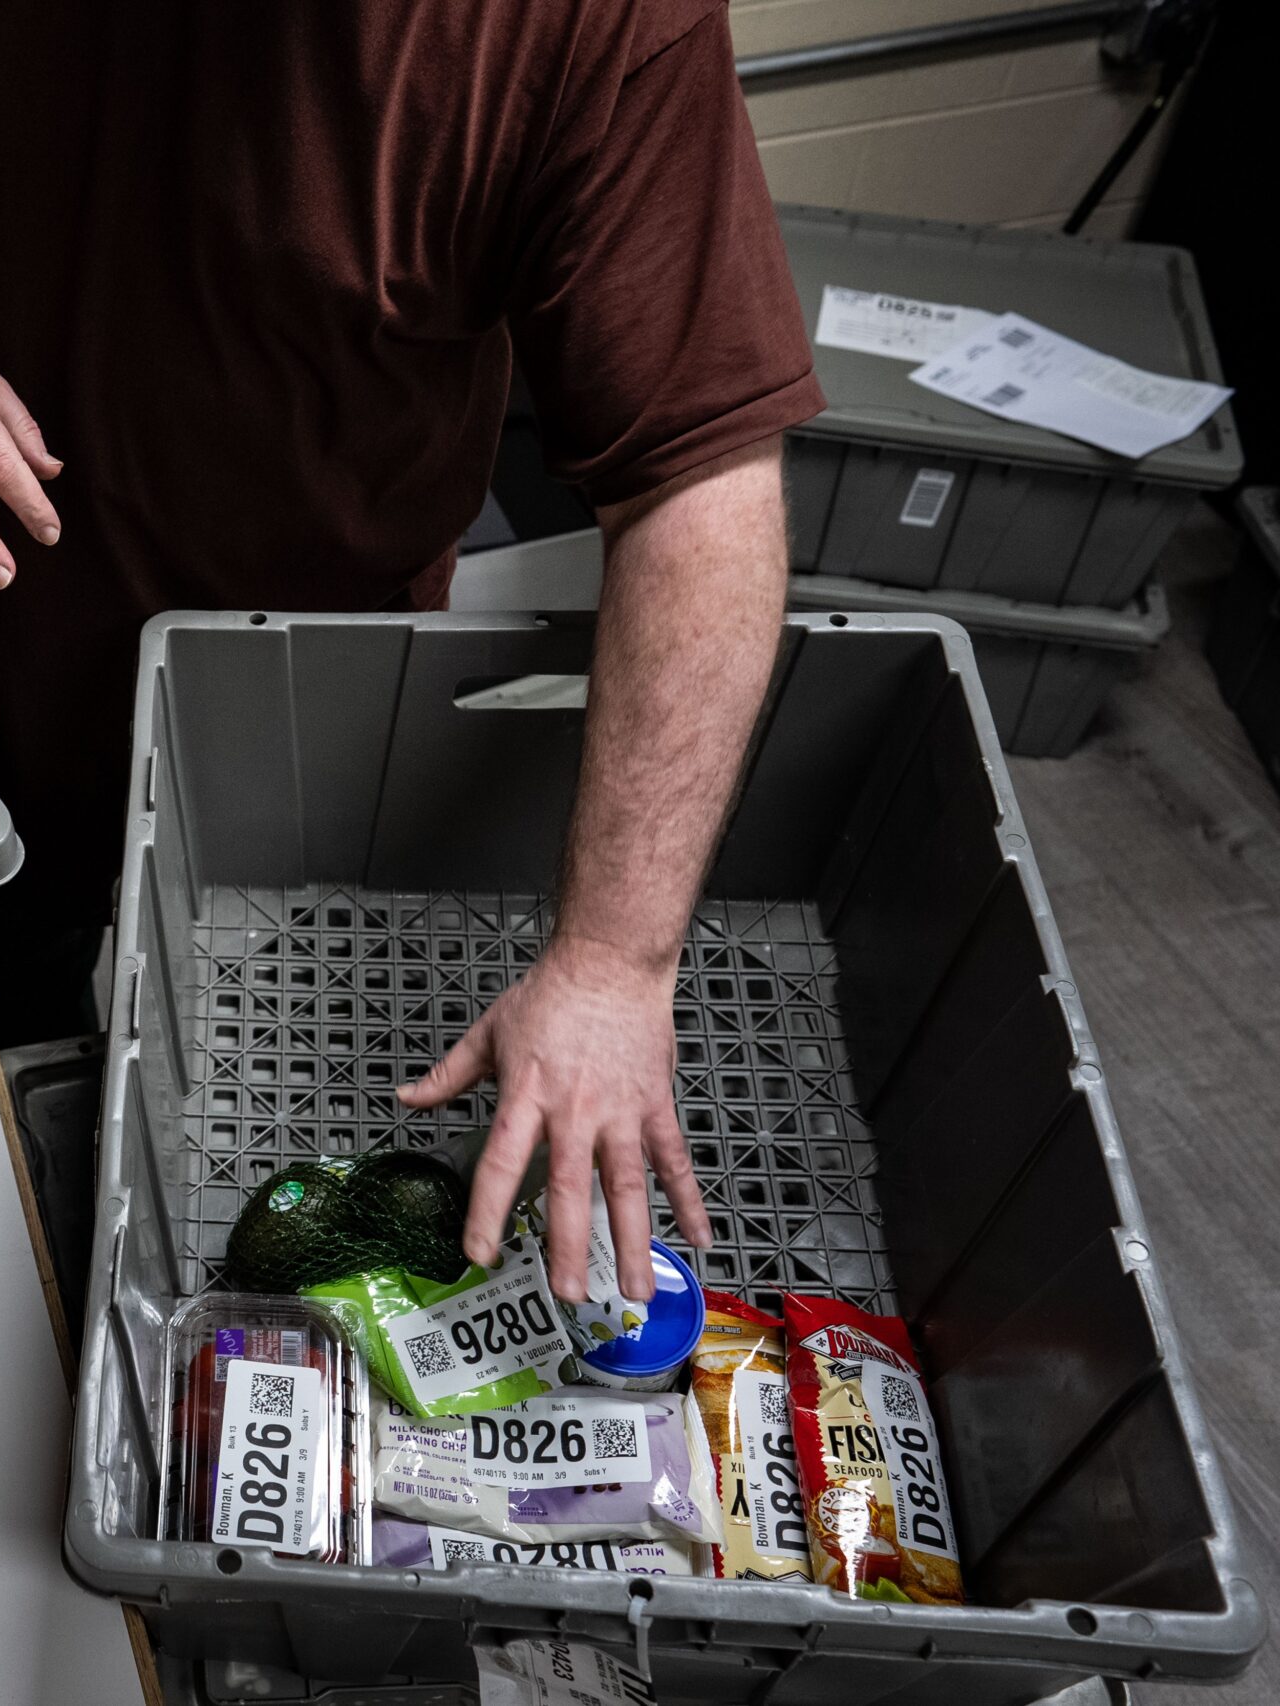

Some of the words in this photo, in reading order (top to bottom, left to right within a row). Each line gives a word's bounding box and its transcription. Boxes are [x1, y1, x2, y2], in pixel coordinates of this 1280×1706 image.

[597, 1241, 616, 1268] MEXICO
[503, 1274, 533, 1291] 49740176
[475, 1293, 488, 1303] AM
[487, 1286, 501, 1298] 9:00
[457, 1300, 470, 1311] 3/9
[431, 1310, 447, 1321] Subs
[450, 1289, 557, 1365] D826
[523, 1338, 566, 1361] Bowman,
[825, 1329, 907, 1373] LOUISIANA
[514, 1355, 525, 1368] K
[475, 1371, 485, 1381] 23
[483, 1364, 500, 1377] Bulk
[520, 1400, 529, 1413] K
[551, 1404, 567, 1412] Bulk
[568, 1404, 576, 1412] 15
[229, 1424, 237, 1433] 13
[300, 1416, 310, 1432] Subs
[388, 1425, 417, 1433] MILK
[420, 1426, 467, 1440] CHOCOLA
[471, 1415, 587, 1464] D826
[227, 1434, 237, 1450] Bulk
[397, 1434, 438, 1448] BAKING
[441, 1441, 467, 1452] CHIP
[298, 1448, 309, 1462] 3/9
[748, 1446, 757, 1460] Bulk
[221, 1471, 234, 1482] K
[296, 1471, 307, 1485] AM
[473, 1468, 507, 1480] 49740176
[513, 1470, 530, 1481] 9:00
[531, 1472, 544, 1481] AM
[554, 1470, 567, 1480] 3/9
[583, 1468, 601, 1477] Subs
[834, 1464, 883, 1480] SEAFOOD
[891, 1472, 901, 1481] K
[236, 1421, 292, 1544] D826
[393, 1481, 406, 1493] NET
[405, 1483, 416, 1495] WT
[417, 1485, 429, 1498] 11.5
[429, 1488, 438, 1499] OZ
[750, 1482, 763, 1491] K
[891, 1425, 948, 1551] D826
[295, 1486, 306, 1504] 9:00
[762, 1432, 808, 1550] D826
[216, 1484, 234, 1536] Bowman,
[898, 1486, 908, 1540] Bowman,
[292, 1509, 305, 1547] 49740176
[756, 1495, 769, 1548] Bowman,
[636, 1547, 664, 1557] MILK
